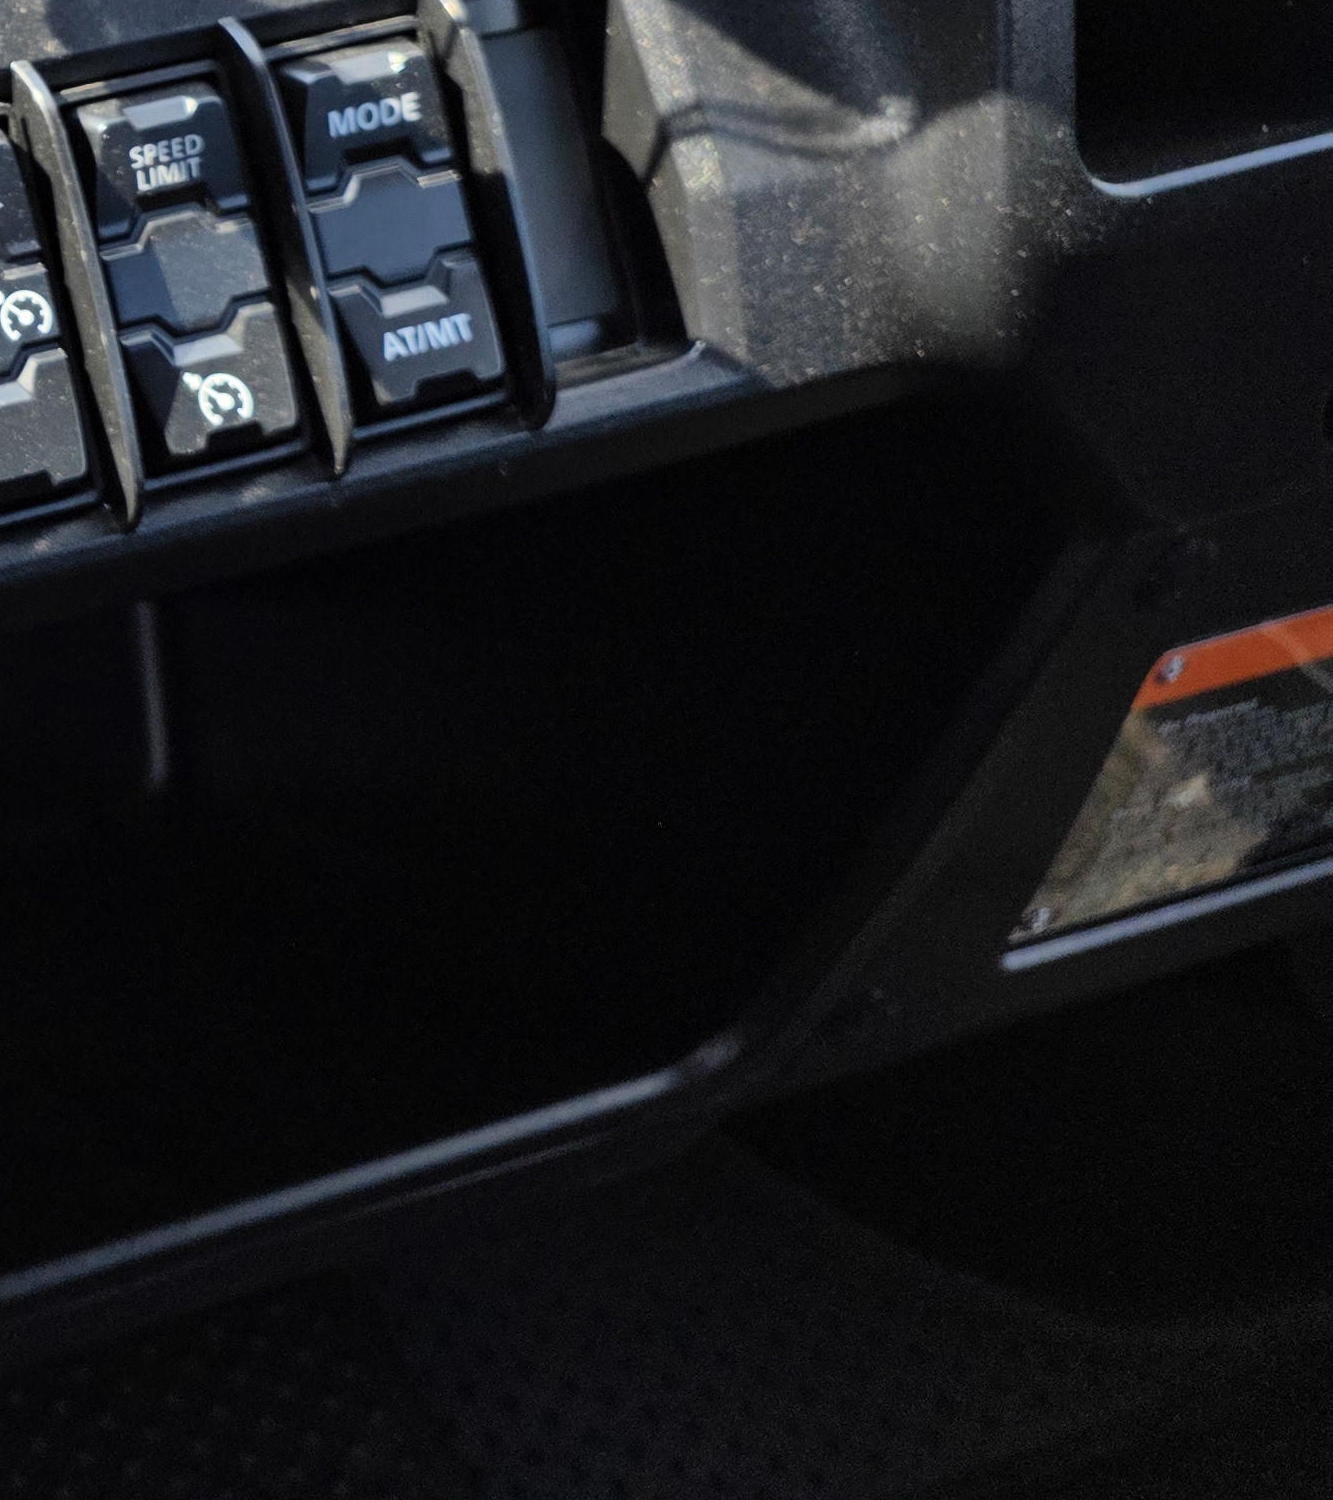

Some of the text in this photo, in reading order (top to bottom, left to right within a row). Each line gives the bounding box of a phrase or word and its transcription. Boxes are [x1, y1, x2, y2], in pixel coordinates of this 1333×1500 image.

[327, 91, 421, 138] MODE
[129, 133, 204, 171] SPEED
[135, 157, 202, 193] LIMIT
[383, 312, 473, 362] AT/MT
